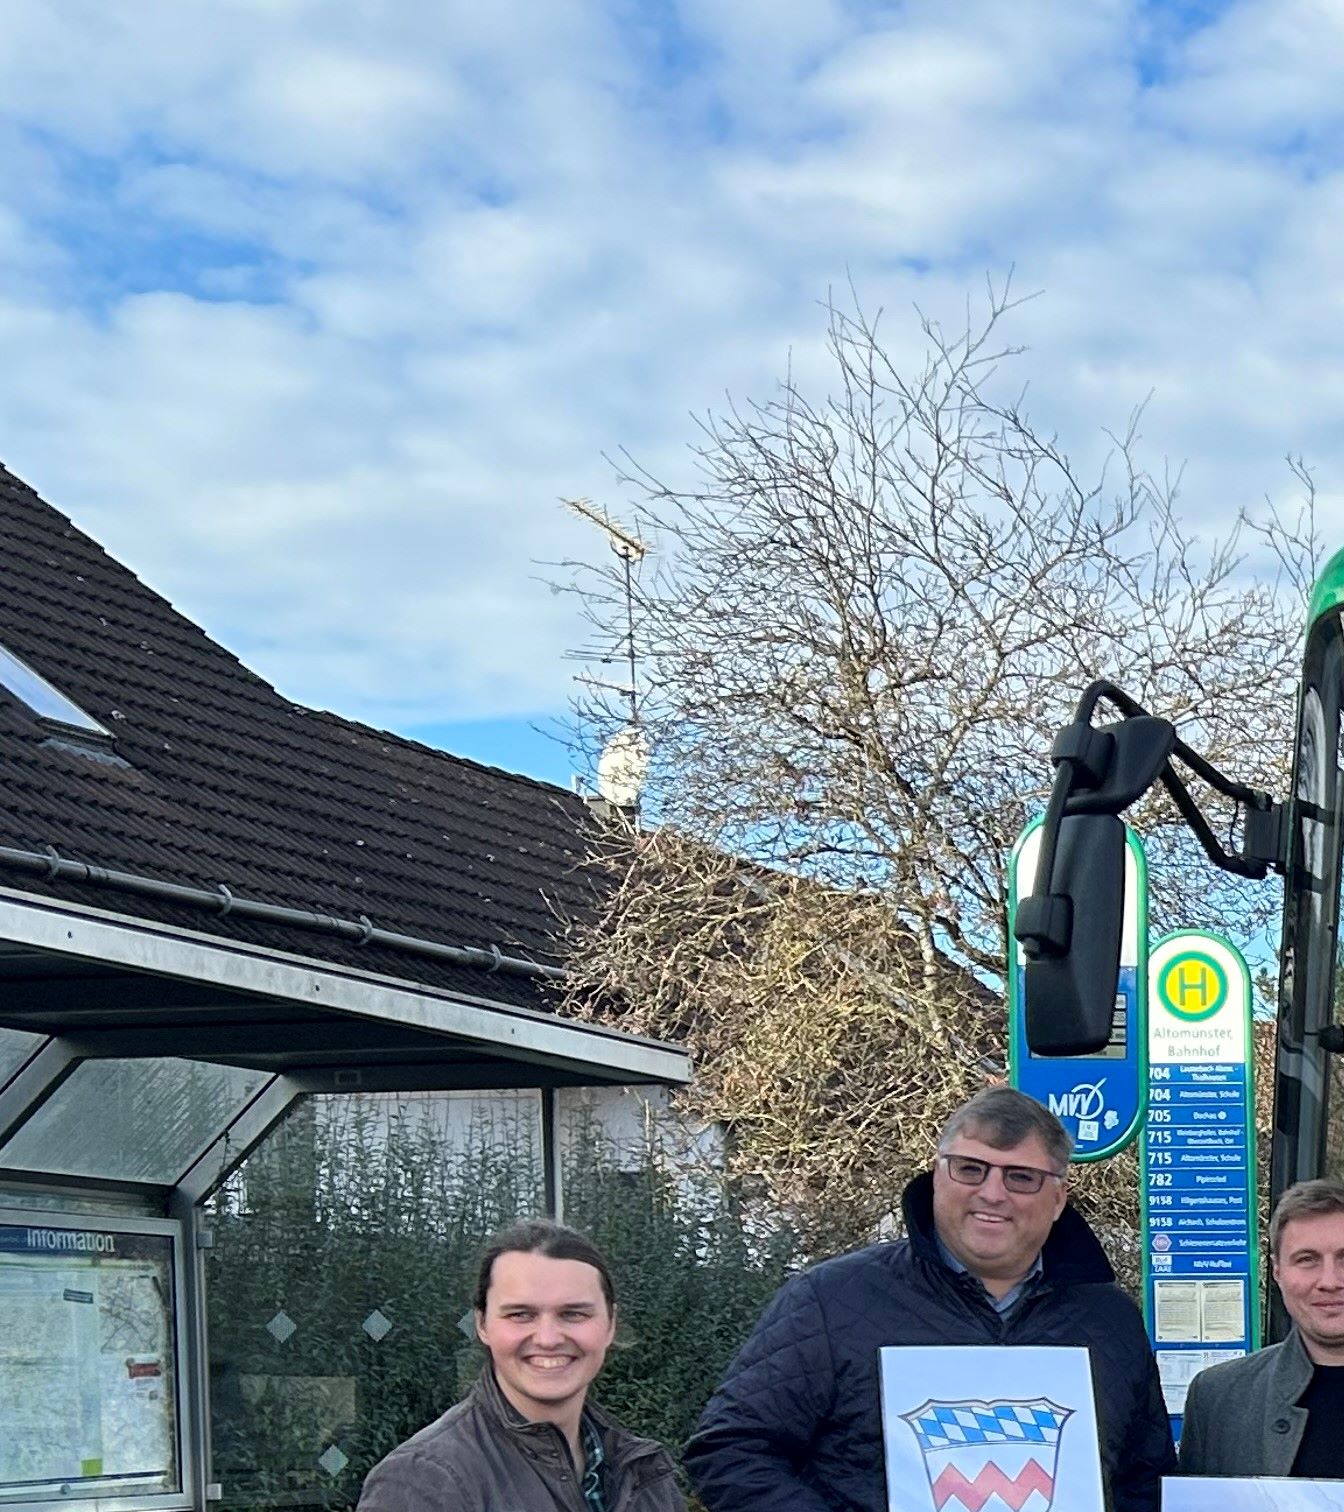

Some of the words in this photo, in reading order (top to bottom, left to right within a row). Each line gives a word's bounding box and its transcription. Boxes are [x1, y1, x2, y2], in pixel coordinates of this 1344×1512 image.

[1179, 967, 1207, 1006] H
[1167, 1045, 1220, 1057] Bahnhof
[1048, 1085, 1104, 1119] MVV
[1147, 1109, 1171, 1122] 705
[1147, 1130, 1172, 1144] 715
[1147, 1151, 1172, 1165] 715
[1148, 1173, 1173, 1187] 782
[27, 1228, 115, 1253] Information
